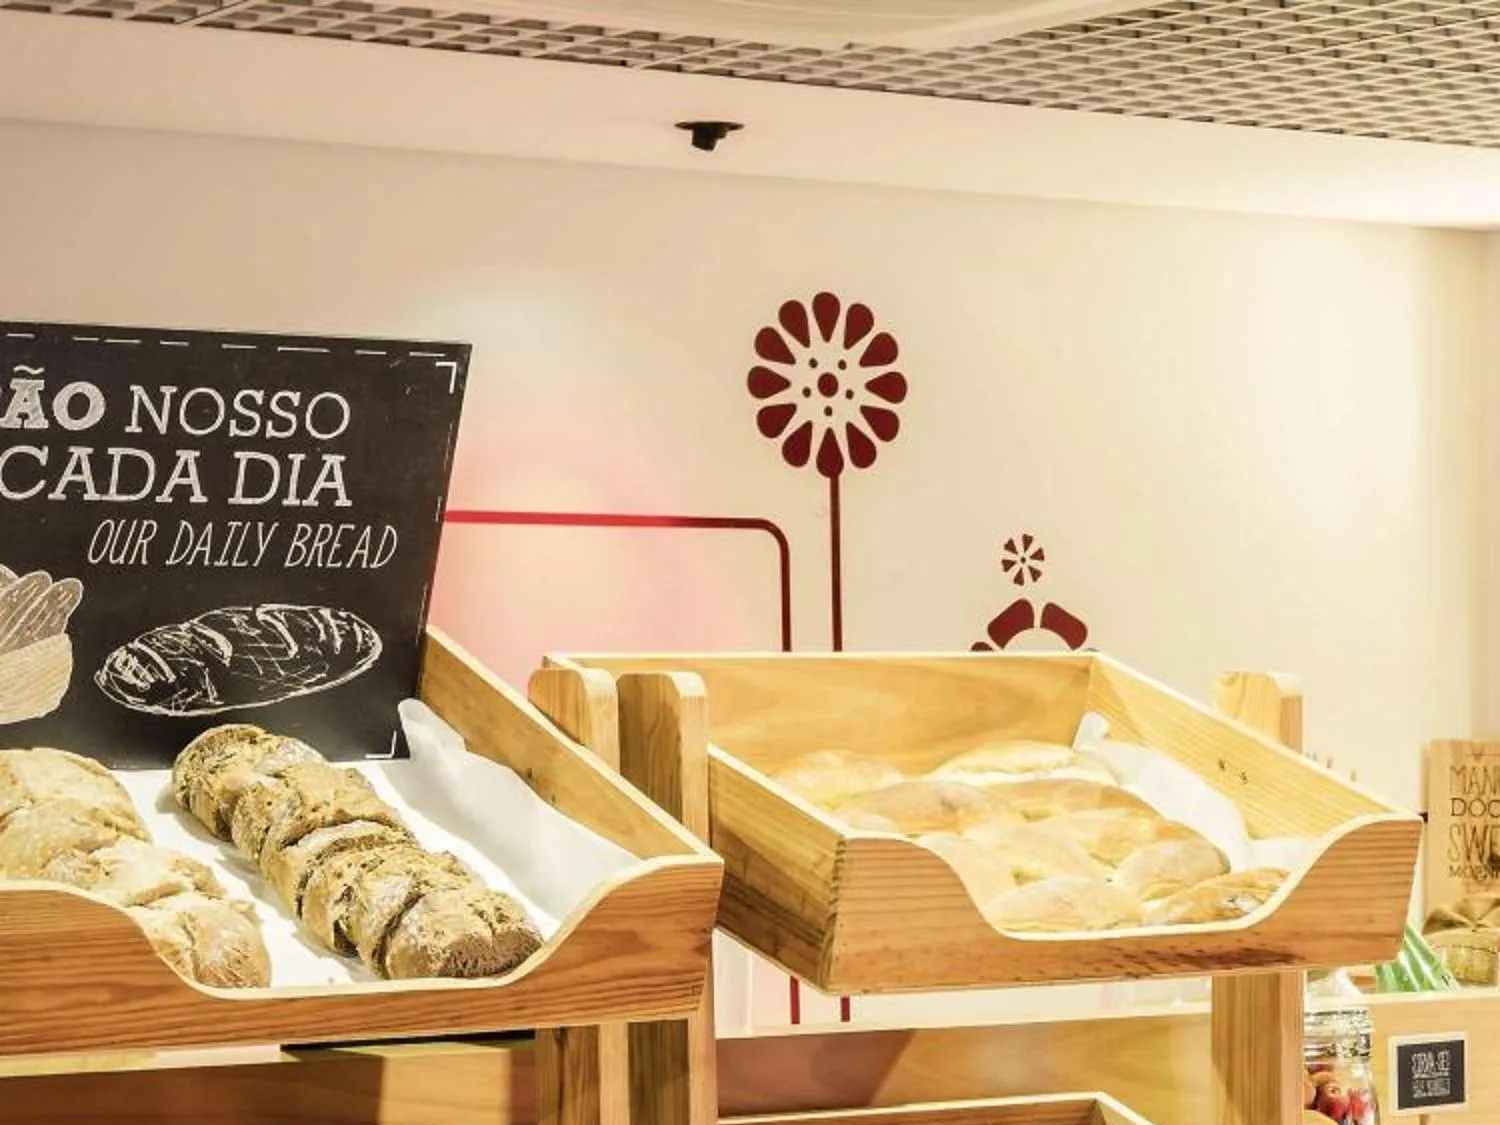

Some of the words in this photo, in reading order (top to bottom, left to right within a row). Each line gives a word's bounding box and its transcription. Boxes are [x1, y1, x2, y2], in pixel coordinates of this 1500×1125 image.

[0, 364, 106, 431] ÃO
[125, 385, 350, 440] NOSSO
[0, 445, 208, 503] CADA
[228, 450, 353, 507] DIA
[86, 519, 158, 566] OUR
[165, 519, 280, 568] DAILY
[283, 523, 398, 569] BREAD
